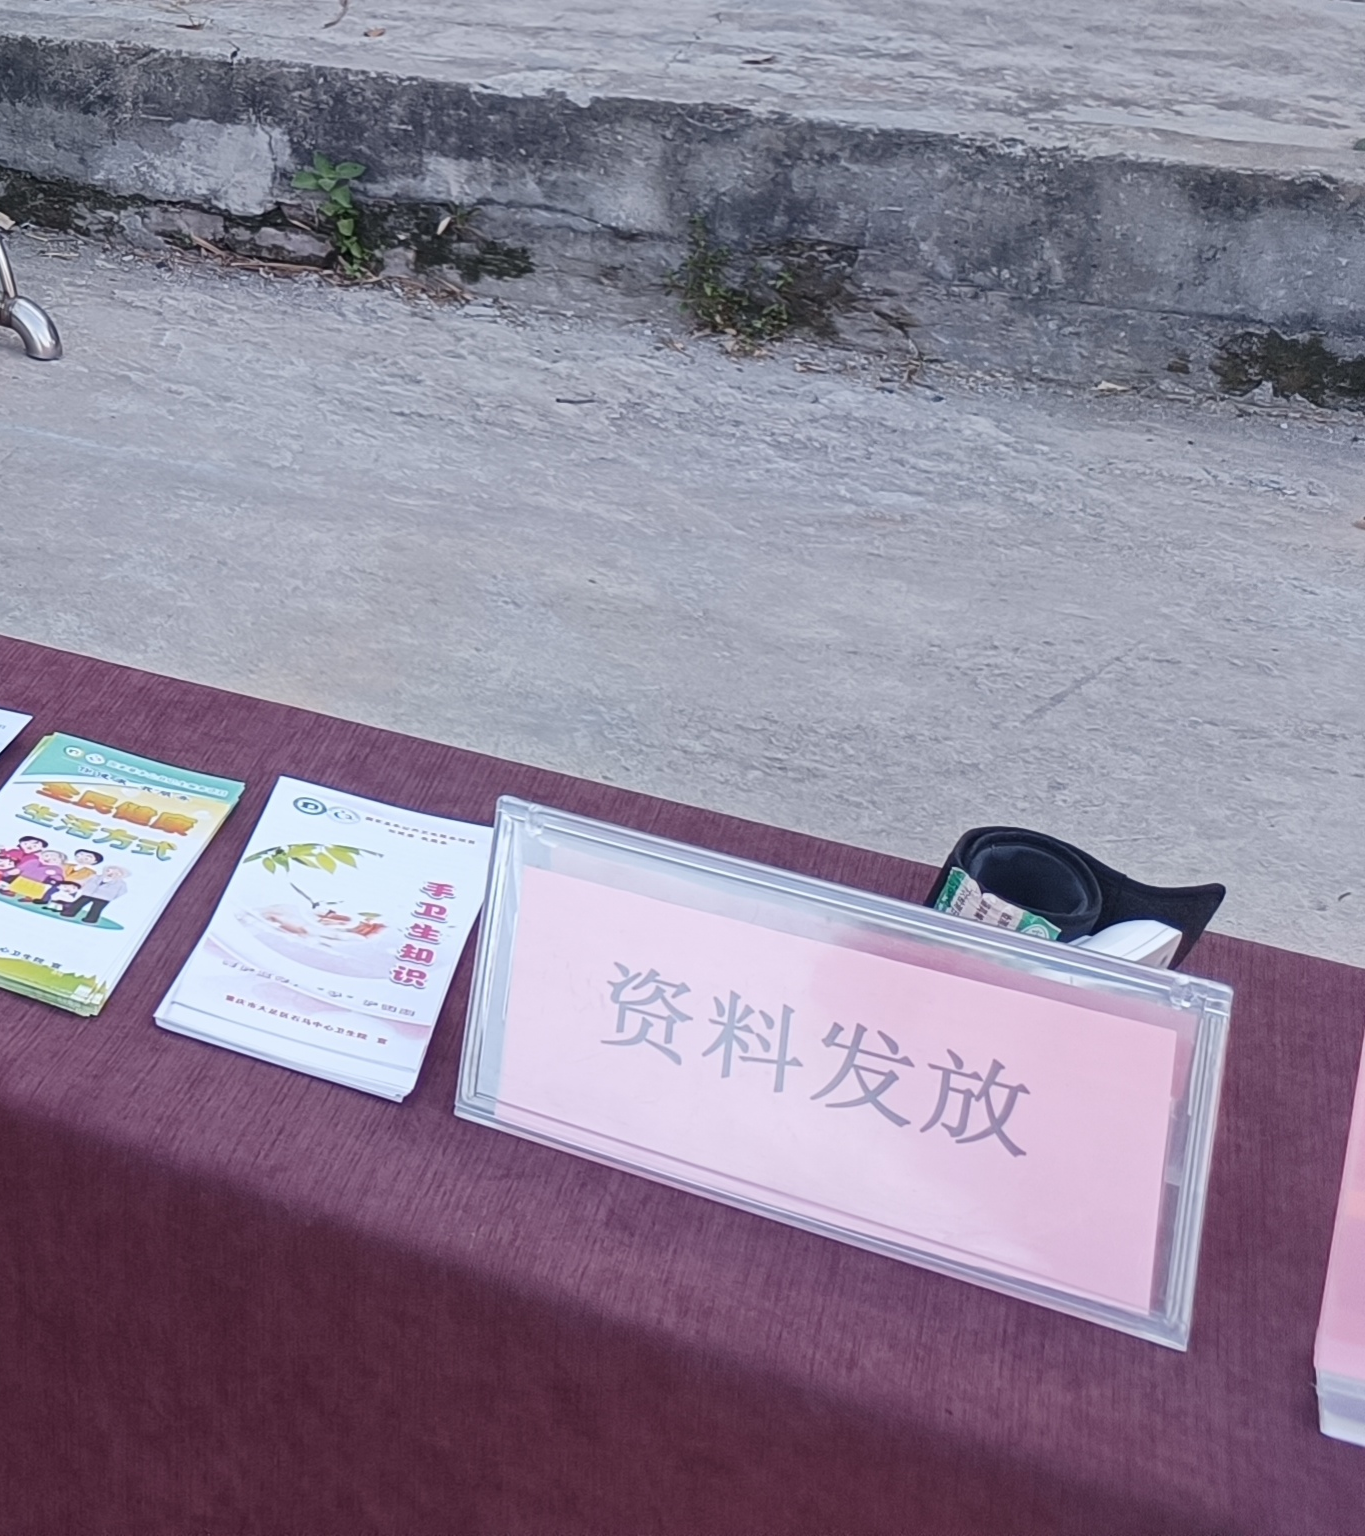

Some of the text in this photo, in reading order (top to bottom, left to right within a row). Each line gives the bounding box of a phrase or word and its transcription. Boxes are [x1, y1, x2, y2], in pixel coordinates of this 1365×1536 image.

[15, 802, 180, 863] 生活方式
[34, 779, 200, 837] 全民健康
[389, 879, 457, 990] 手卫生知识
[600, 960, 1031, 1160] 资料发放
